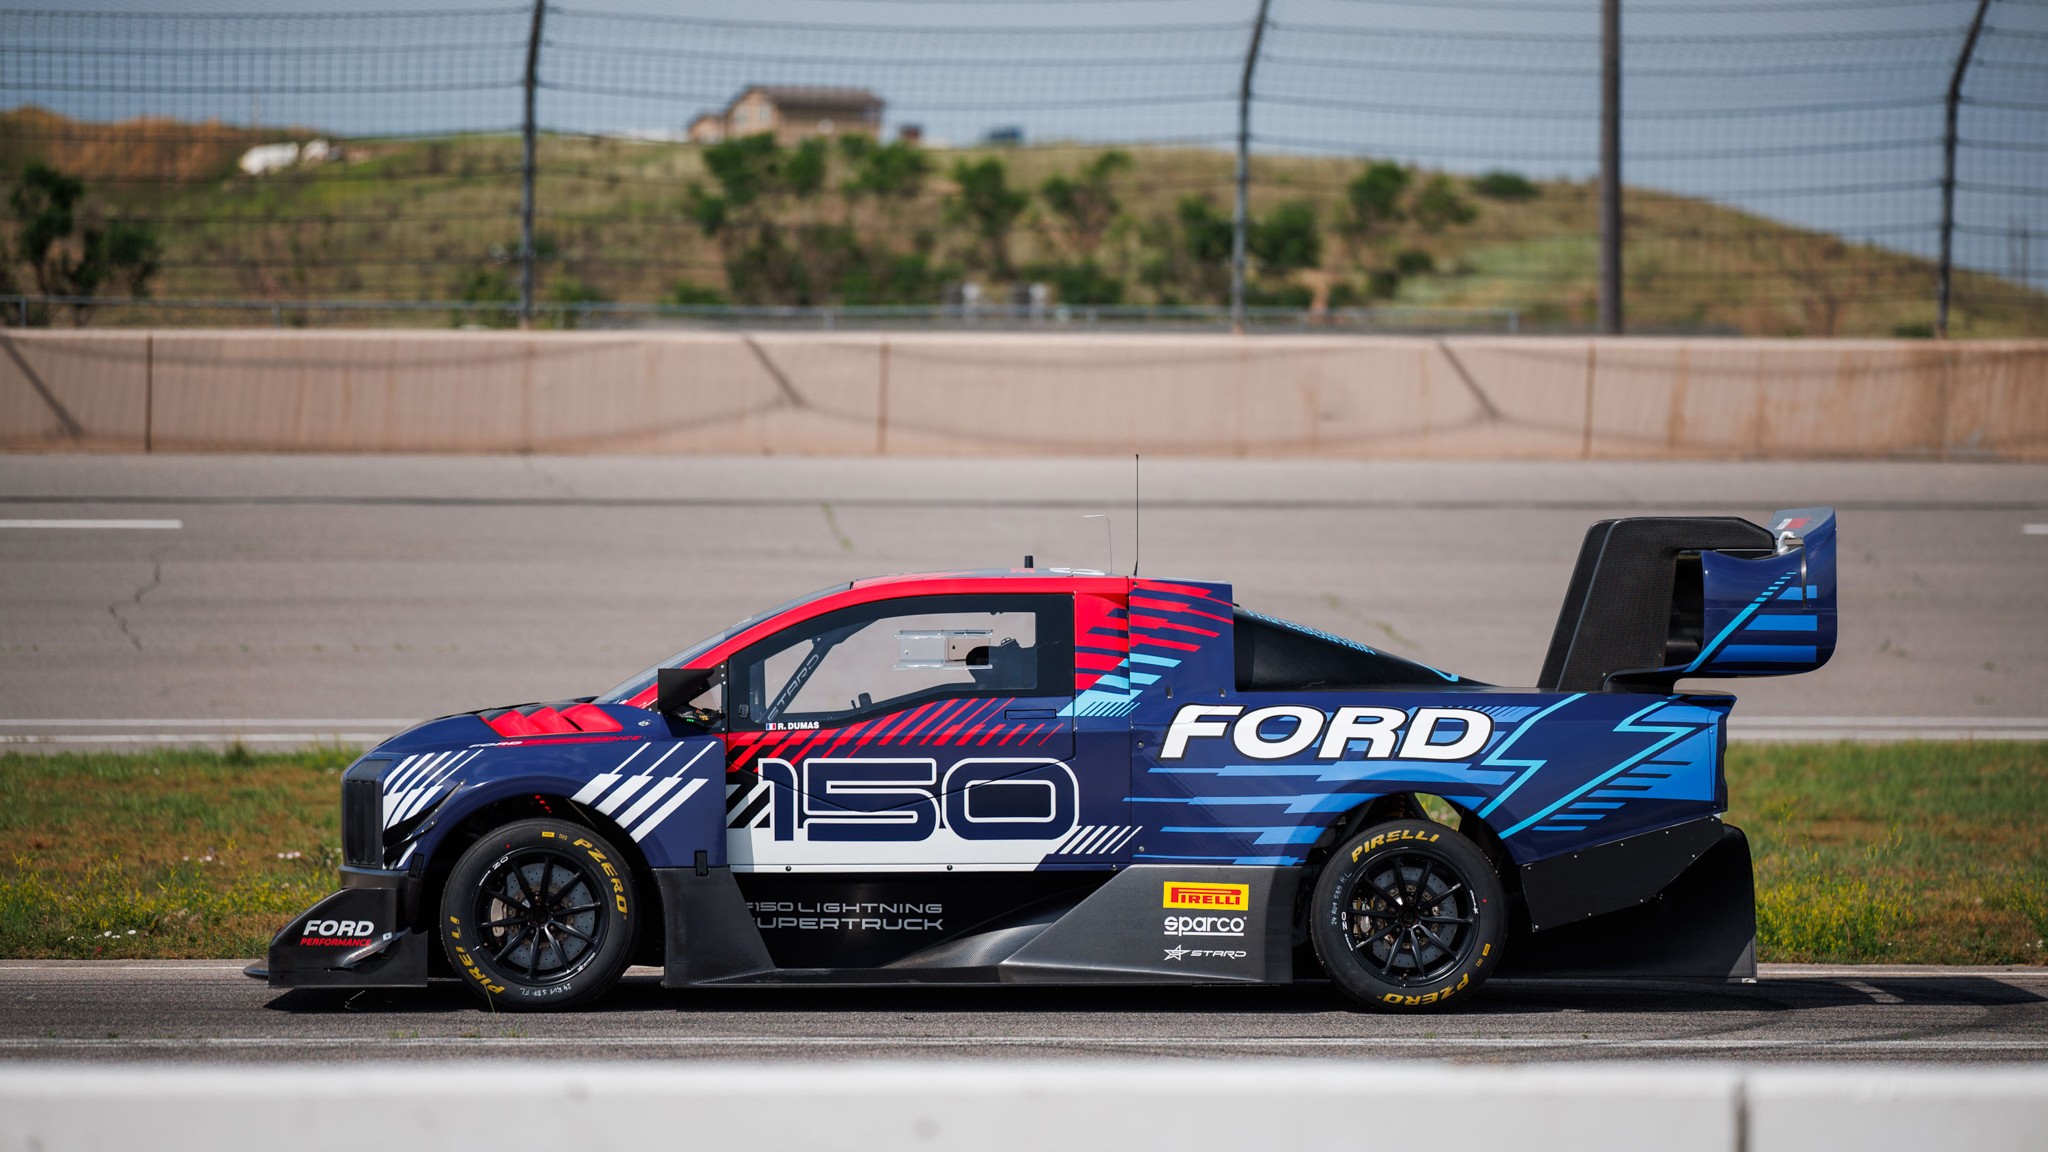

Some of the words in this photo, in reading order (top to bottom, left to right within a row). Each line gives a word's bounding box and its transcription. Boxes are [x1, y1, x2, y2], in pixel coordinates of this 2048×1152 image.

[767, 654, 819, 722] STARD
[788, 722, 820, 730] DUMAS
[1158, 703, 1495, 761] FORD
[757, 757, 1079, 841] 150
[1351, 829, 1440, 863] PIRELLI
[573, 838, 628, 914] PZERO
[1170, 887, 1242, 905] PIRELLI
[798, 902, 943, 913] LIGHTNING
[303, 920, 375, 936] FORD
[753, 917, 944, 930] UPERTRUCK
[1164, 916, 1245, 936] sparco
[300, 937, 372, 947] PERFORMANCE
[450, 915, 506, 993] PIRELLI
[1190, 950, 1247, 960] STARD
[1383, 973, 1469, 1005] PZERO
